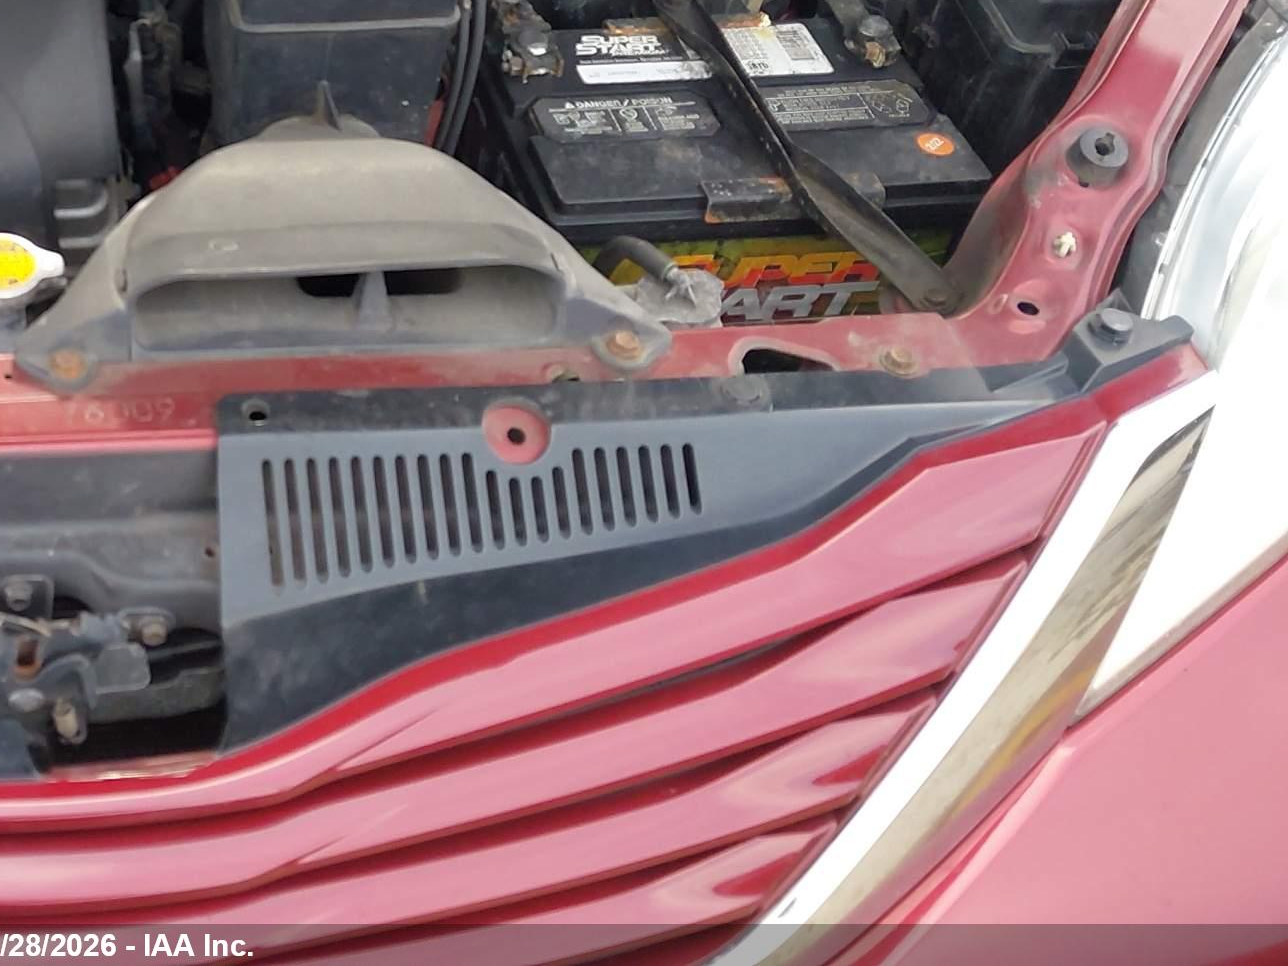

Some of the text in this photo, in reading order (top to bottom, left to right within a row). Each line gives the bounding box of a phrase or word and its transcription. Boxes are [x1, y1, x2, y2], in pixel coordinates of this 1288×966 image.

[580, 35, 660, 45] SUPER
[575, 43, 662, 56] START
[575, 99, 622, 109] DANGER
[632, 96, 673, 106] POISON
